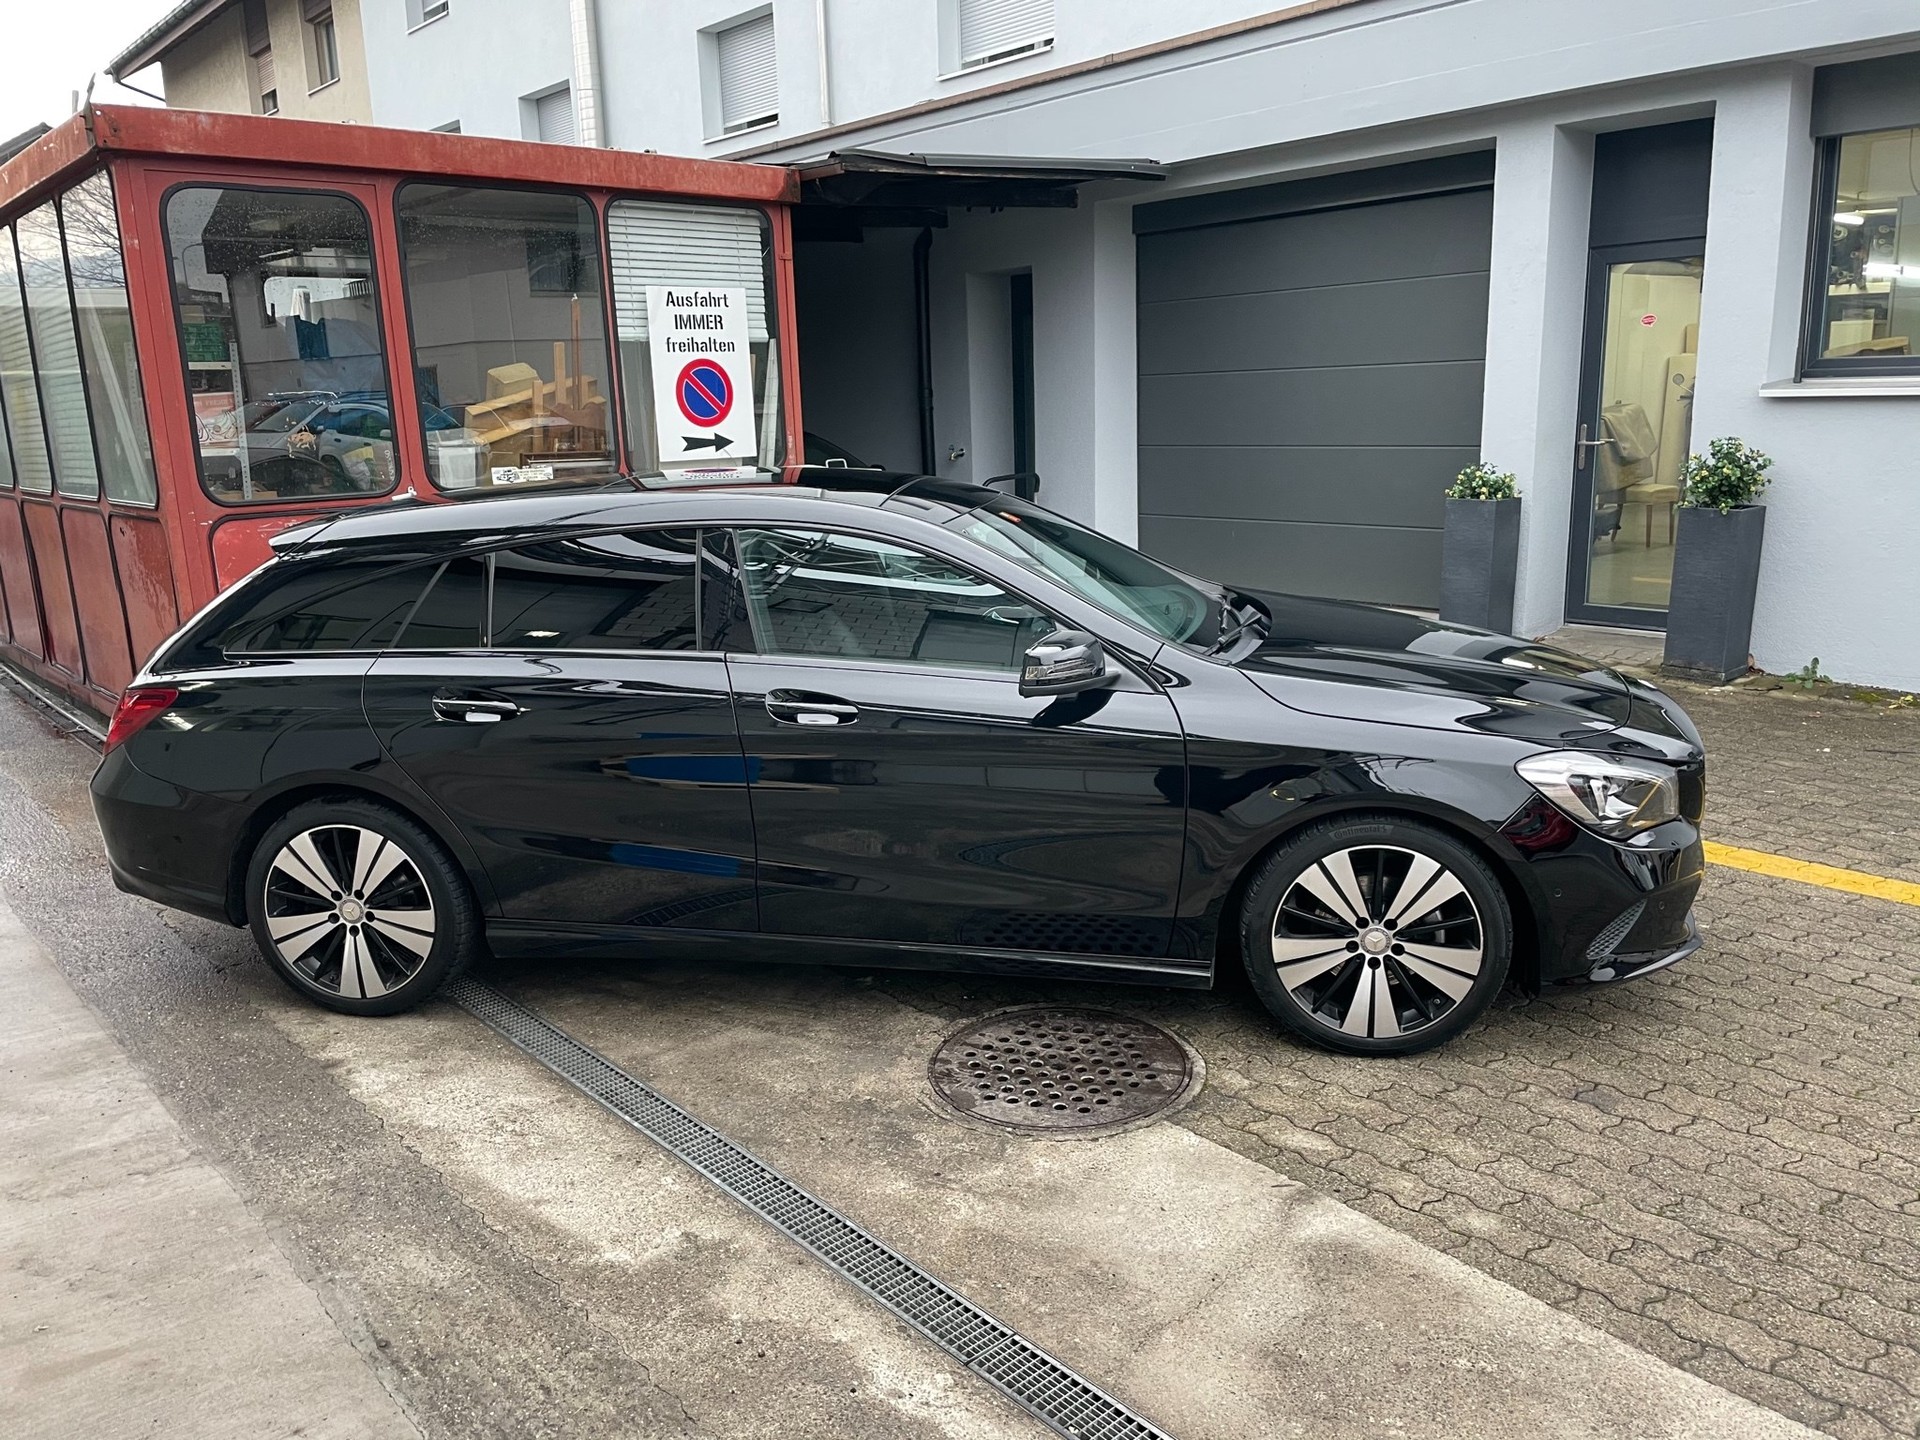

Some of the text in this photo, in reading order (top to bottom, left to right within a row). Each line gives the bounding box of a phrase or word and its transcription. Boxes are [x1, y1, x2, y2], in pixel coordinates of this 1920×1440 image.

[666, 291, 729, 308] Ausfahrt
[674, 314, 724, 330] IMMER
[665, 336, 736, 353] freihalten
